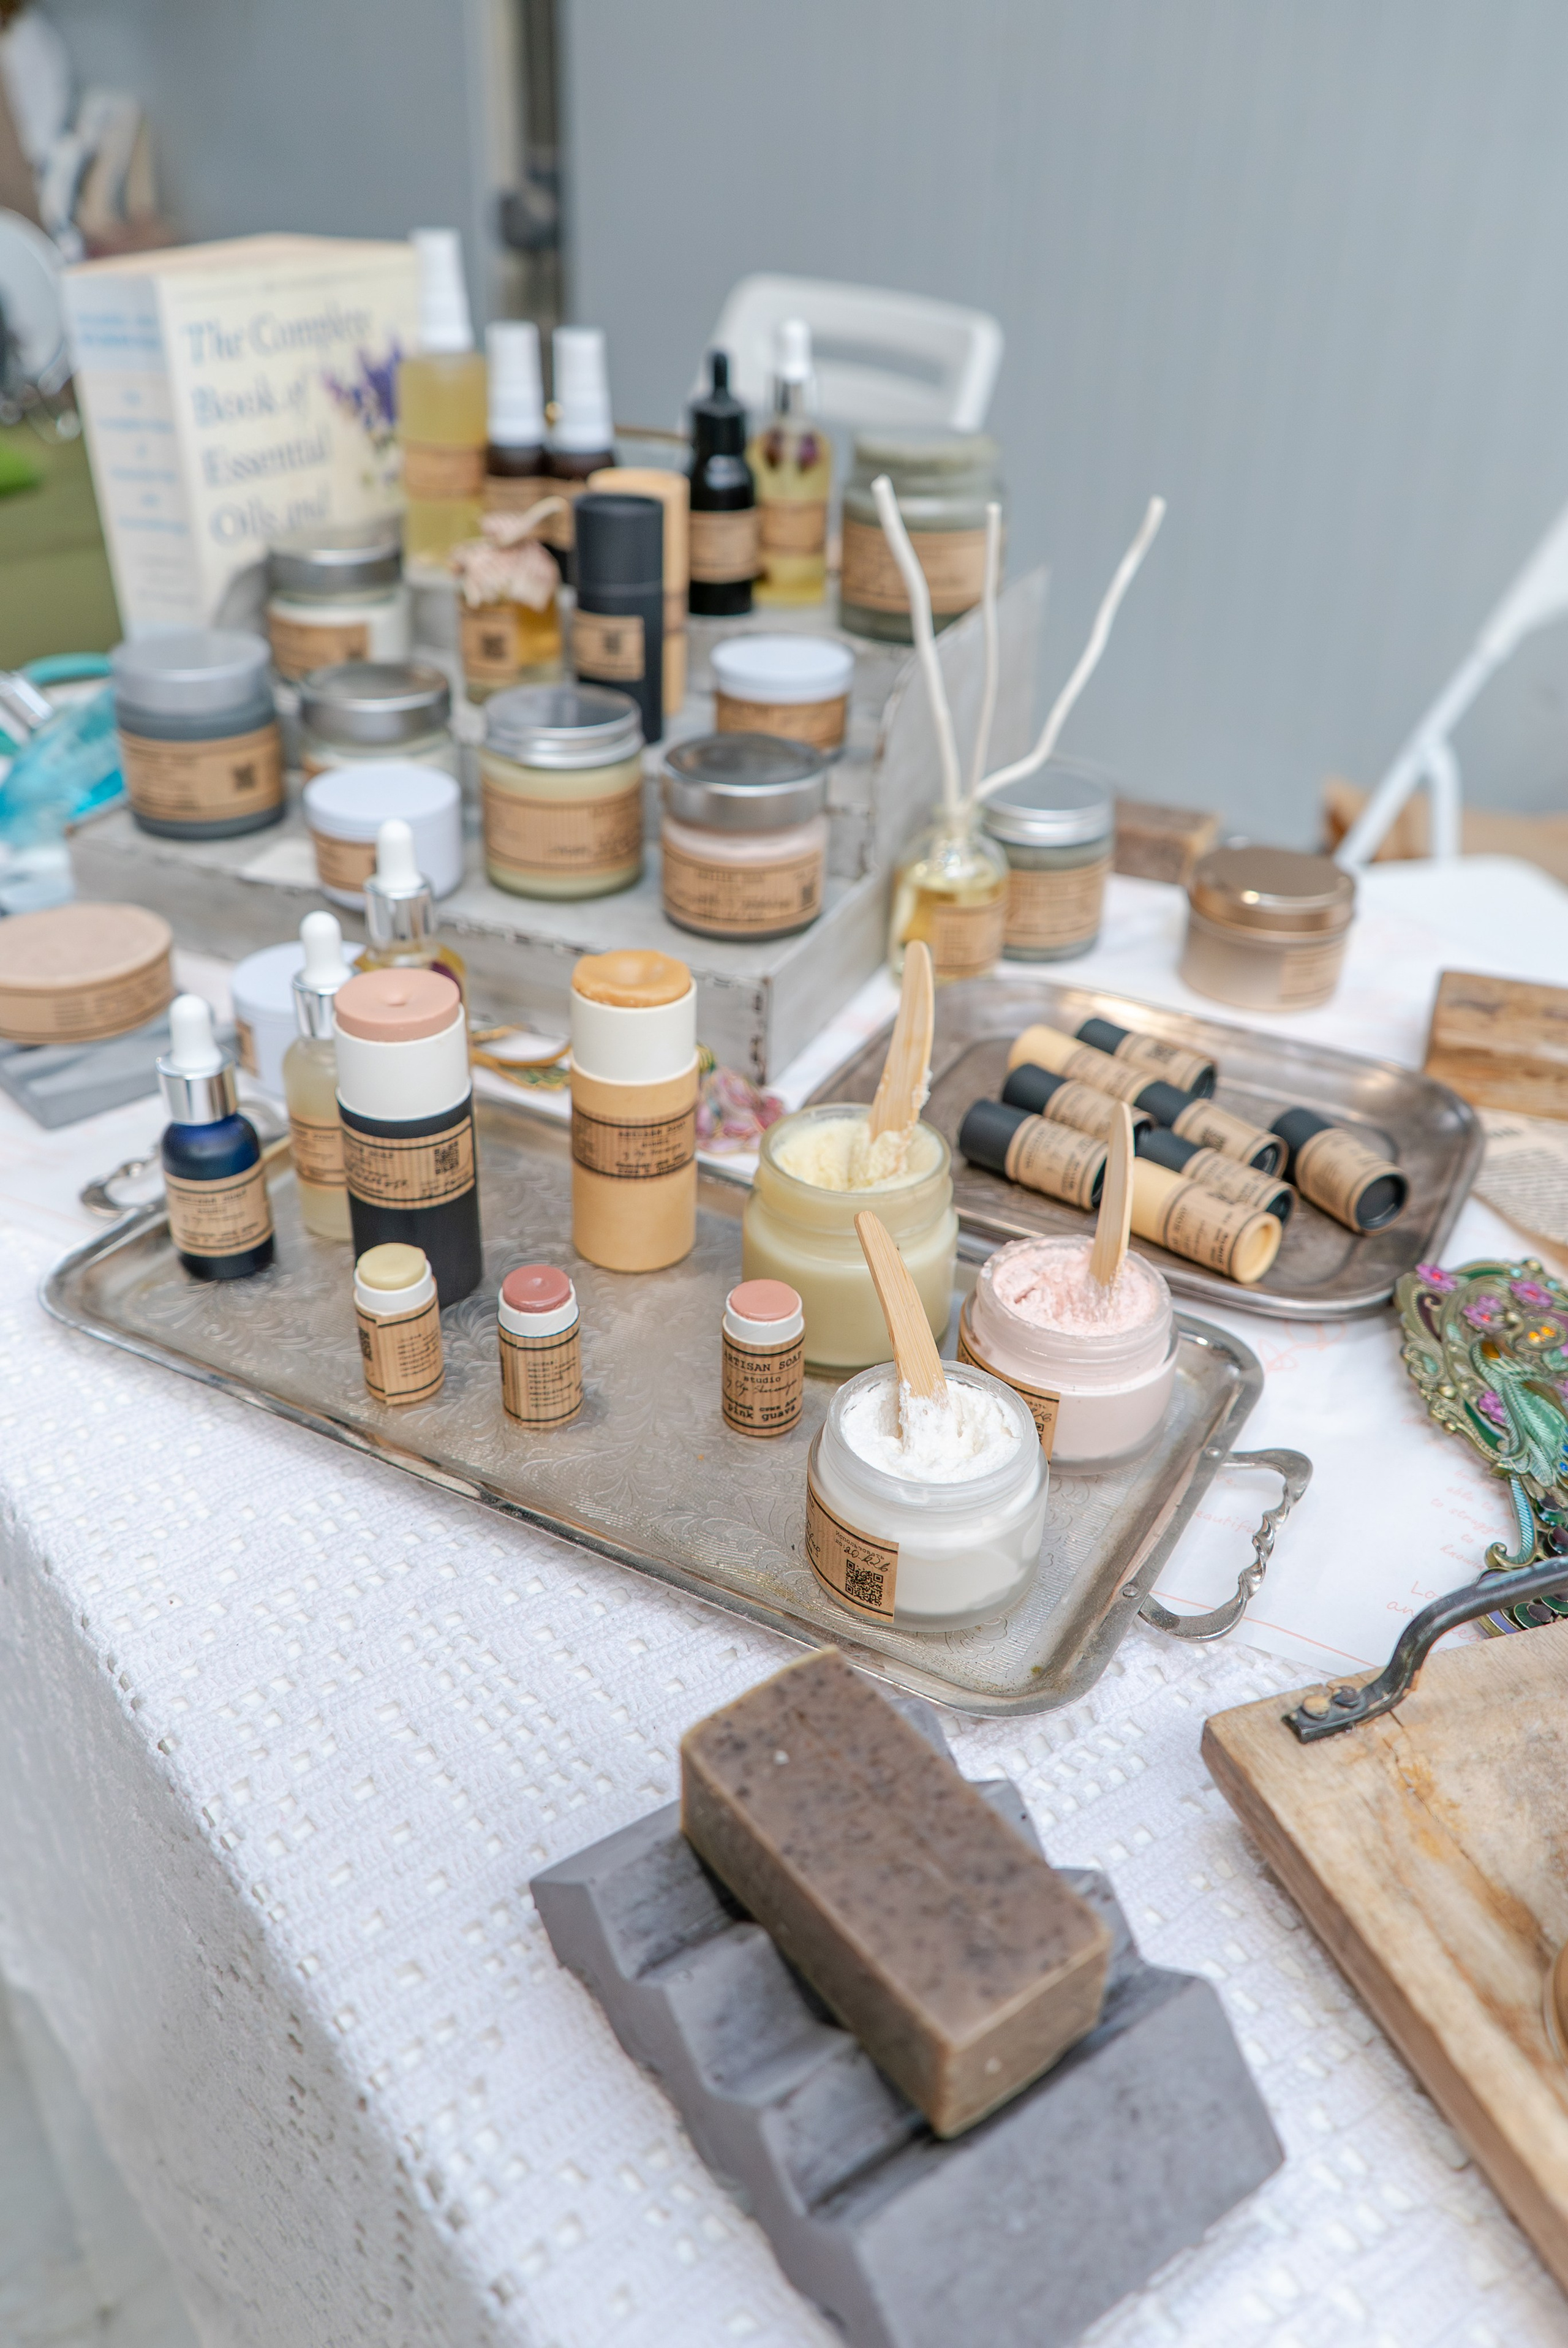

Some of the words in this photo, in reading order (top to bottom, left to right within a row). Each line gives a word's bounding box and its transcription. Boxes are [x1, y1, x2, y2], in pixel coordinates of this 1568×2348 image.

[727, 1403, 754, 1419] pink
[761, 1405, 796, 1421] guava
[835, 1530, 885, 1561] Использовать
